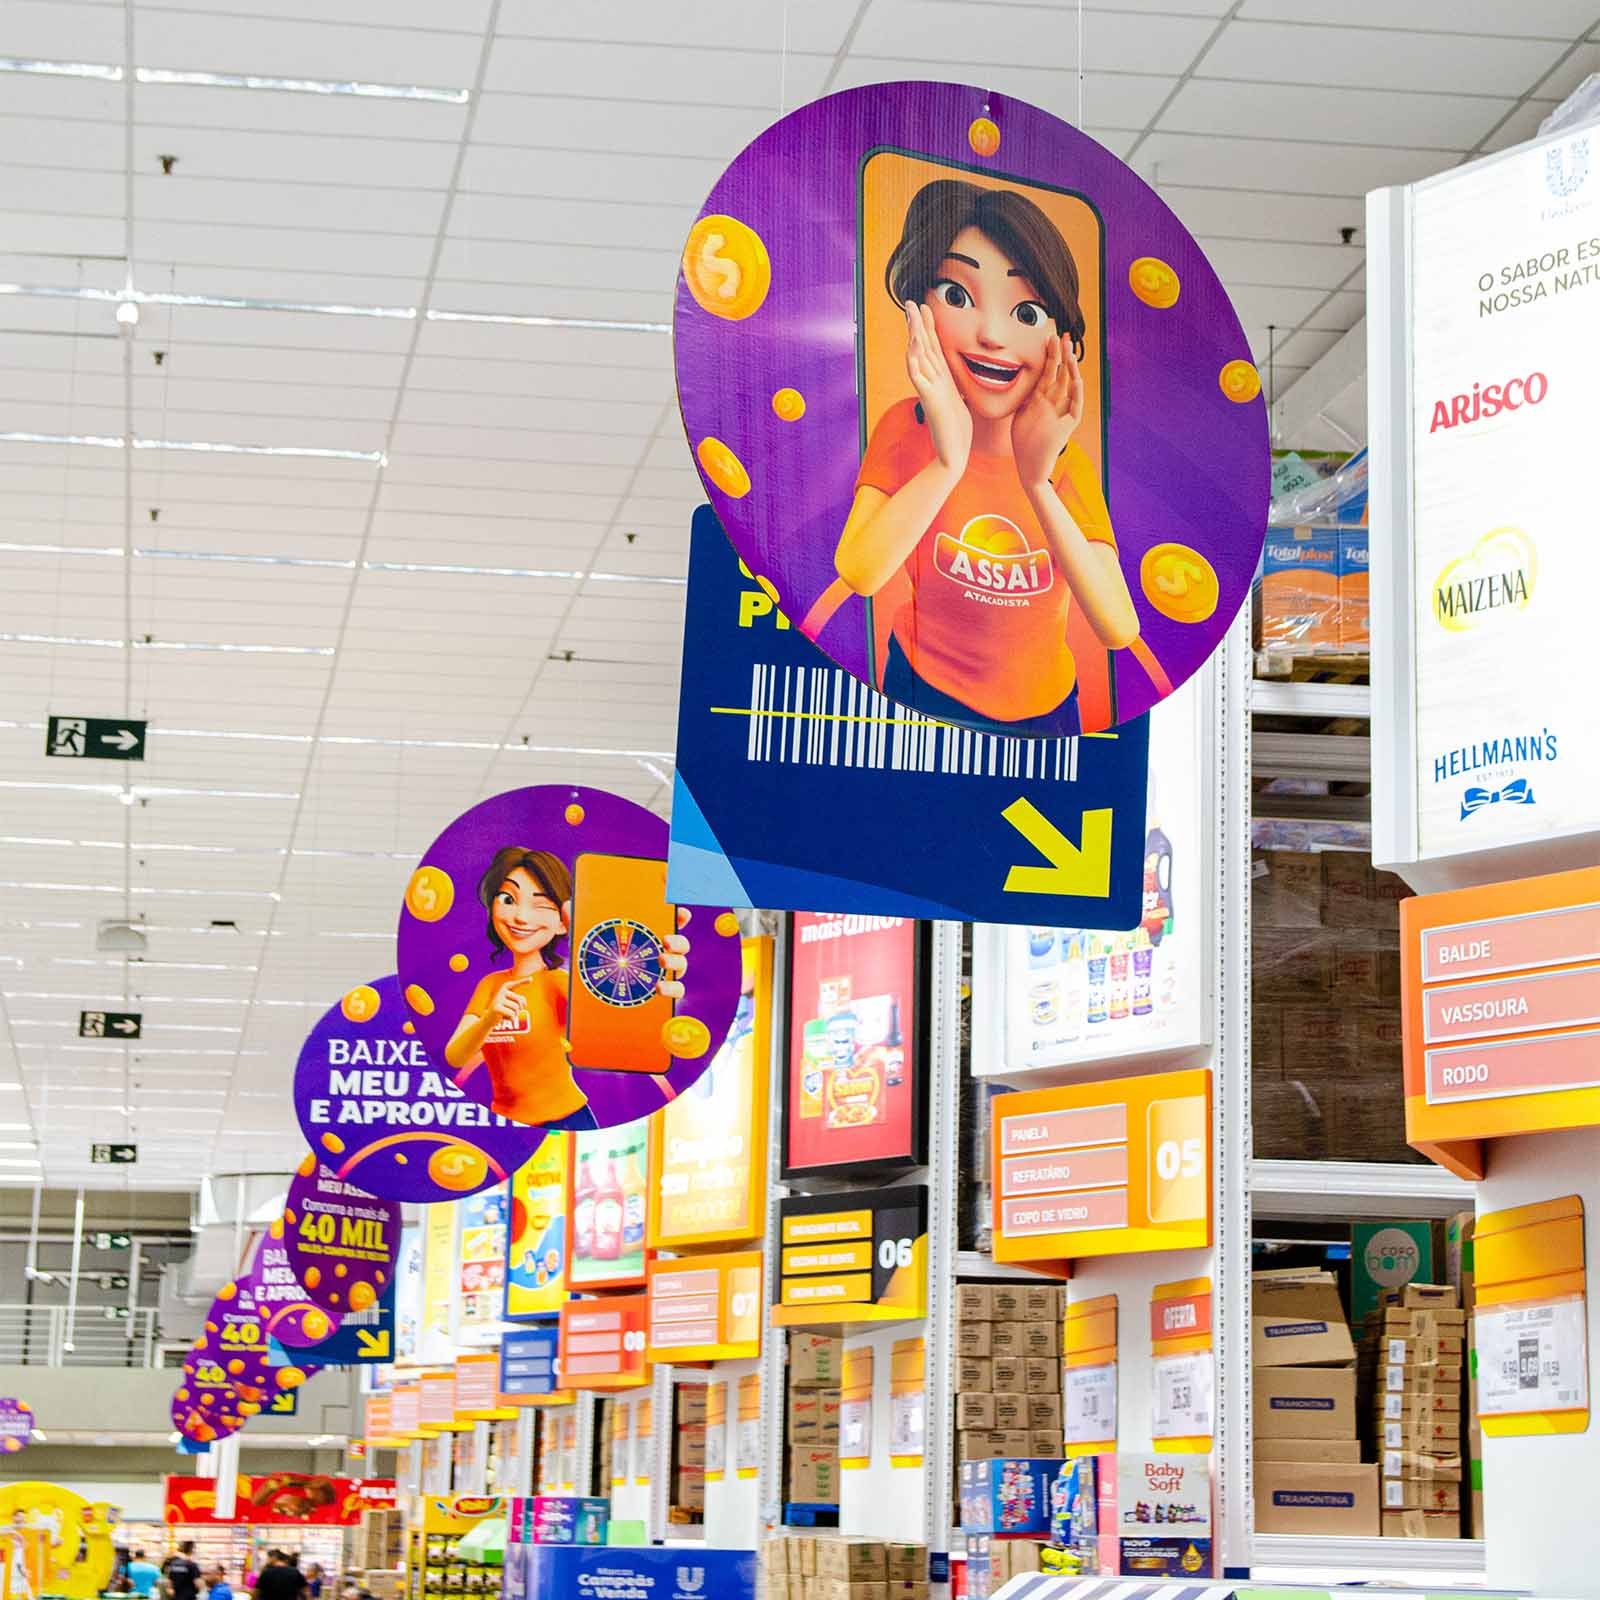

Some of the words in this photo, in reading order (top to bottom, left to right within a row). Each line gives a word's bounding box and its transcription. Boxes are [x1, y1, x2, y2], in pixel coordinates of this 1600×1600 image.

[1478, 273, 1494, 292] O
[1500, 248, 1570, 286] SABOR
[1577, 237, 1600, 261] ES
[1480, 281, 1548, 318] NOSSA
[963, 589, 1031, 607] ATACADISTA
[1437, 568, 1529, 624] MAIZENA
[1434, 727, 1558, 783] HELLMANN'S
[1438, 939, 1492, 964] BALDE
[1441, 996, 1529, 1025] VASSOURA
[328, 1039, 429, 1067] BAIXE
[329, 1070, 410, 1097] MEU
[1442, 1063, 1490, 1086] RODO
[310, 1099, 331, 1123] E
[337, 1099, 535, 1128] APROVEI
[1010, 1126, 1049, 1142] PANELA
[1156, 1138, 1203, 1180] 05
[1041, 1208, 1056, 1223] DE
[299, 1212, 335, 1243] 40
[341, 1216, 389, 1252] MIL
[878, 1238, 913, 1269] 06
[254, 1285, 266, 1301] E
[221, 1322, 261, 1345] 40
[1144, 1461, 1185, 1480] Baby
[1148, 1476, 1181, 1494] Soft
[1279, 1493, 1350, 1506] TRAMONTINA
